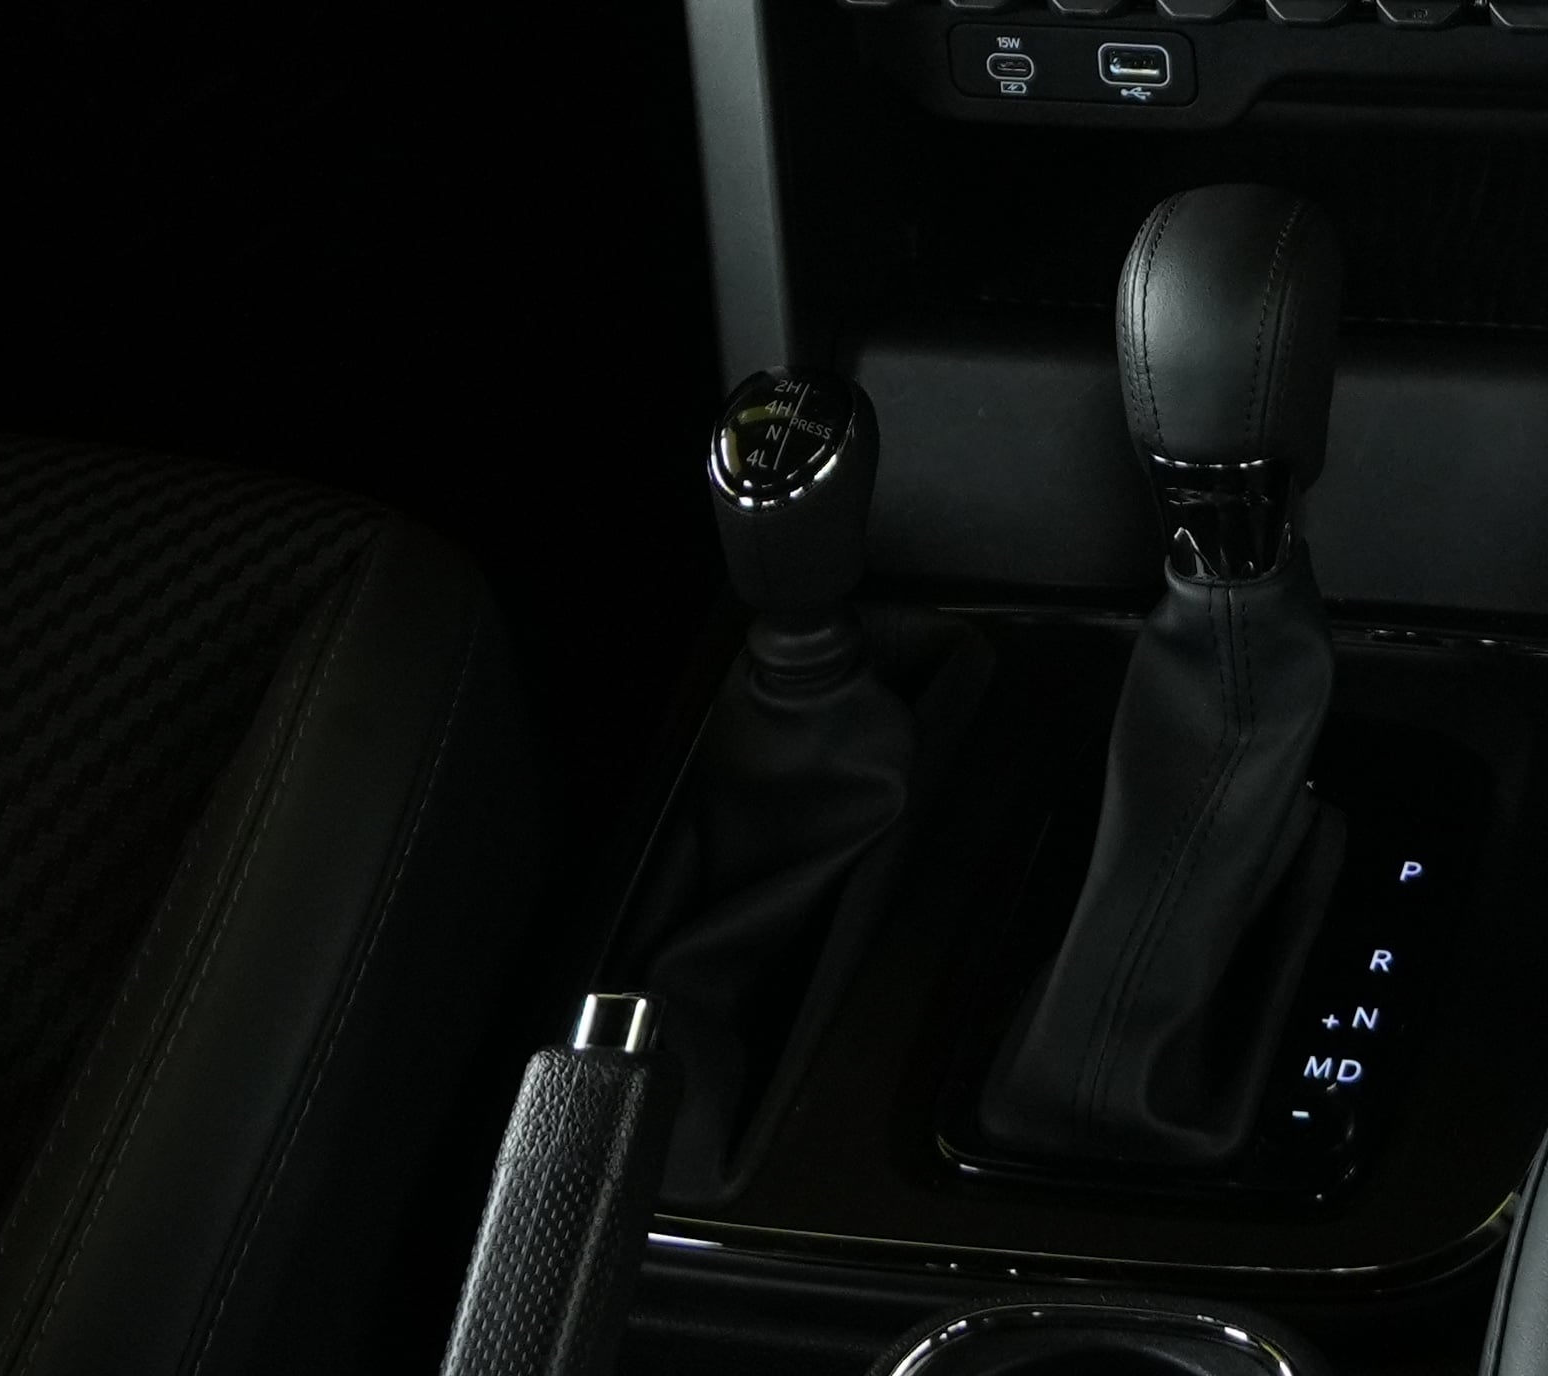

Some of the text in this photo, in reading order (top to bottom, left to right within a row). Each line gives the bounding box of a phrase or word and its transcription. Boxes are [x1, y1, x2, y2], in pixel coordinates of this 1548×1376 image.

[996, 36, 1021, 49] 15W
[774, 378, 803, 394] 2H
[764, 399, 793, 417] 4H
[765, 424, 783, 441] N
[790, 416, 833, 440] PRESS
[745, 448, 768, 468] 4L
[1399, 860, 1423, 882] P
[1369, 948, 1393, 972] R
[1351, 1006, 1379, 1030] N
[1303, 1055, 1363, 1083] M D
